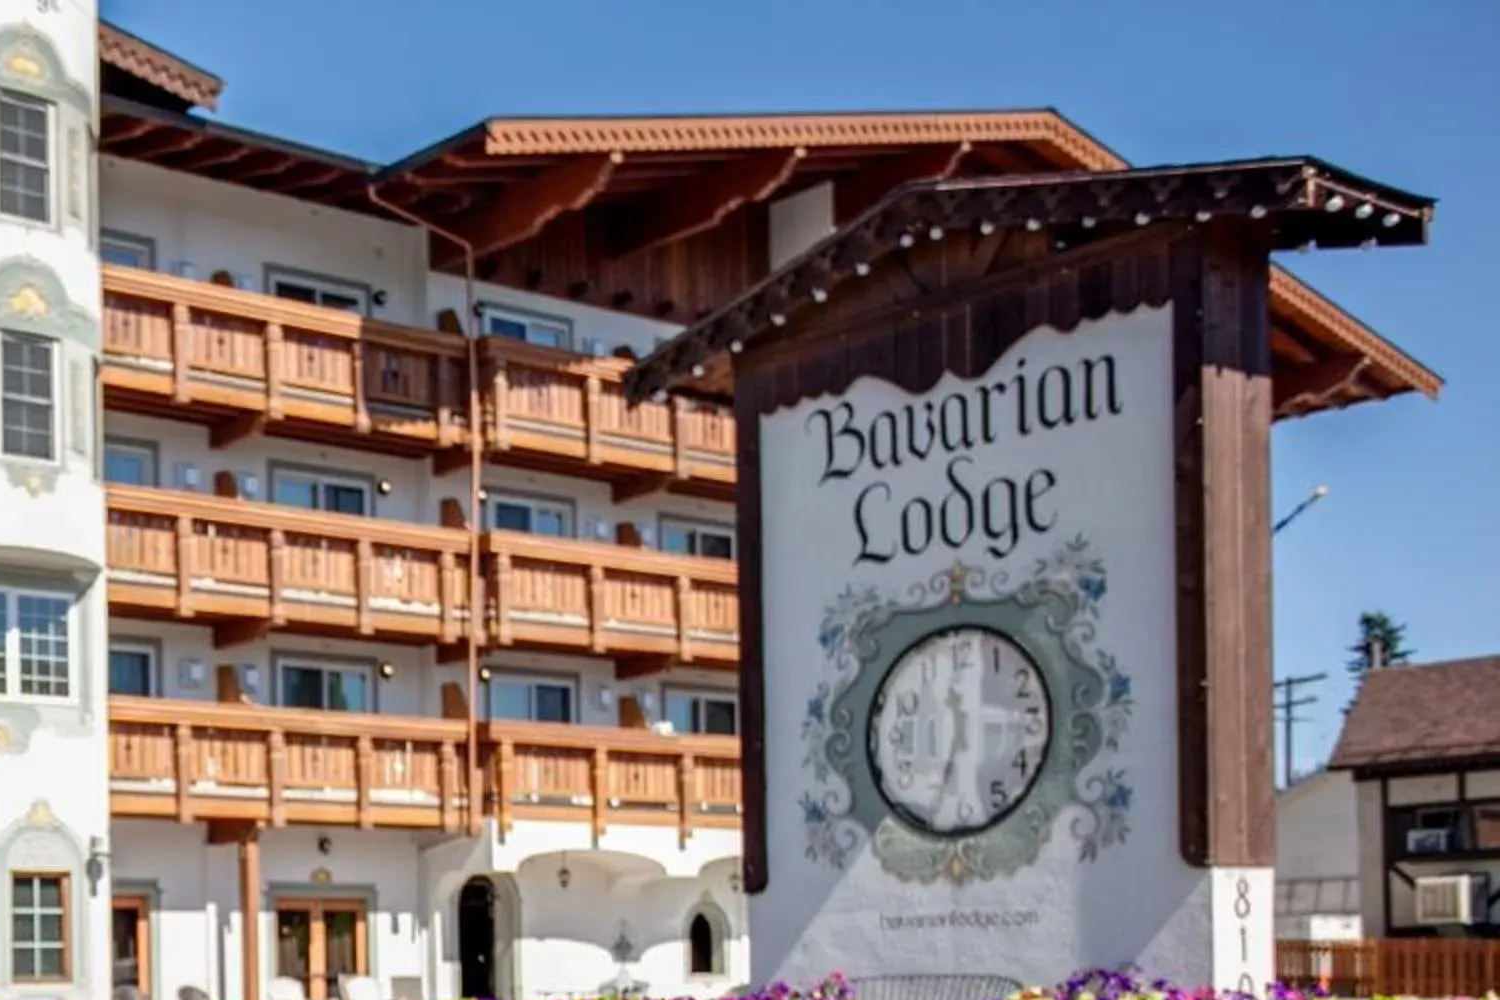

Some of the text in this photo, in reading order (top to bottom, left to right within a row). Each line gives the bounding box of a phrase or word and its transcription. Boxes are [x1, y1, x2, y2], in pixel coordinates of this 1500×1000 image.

[804, 354, 1124, 487] Bavarian
[852, 455, 1058, 567] Lodge
[992, 646, 1001, 674] 1
[1013, 668, 1031, 699] 2
[1011, 747, 1028, 778] 4
[989, 780, 1009, 810] 5
